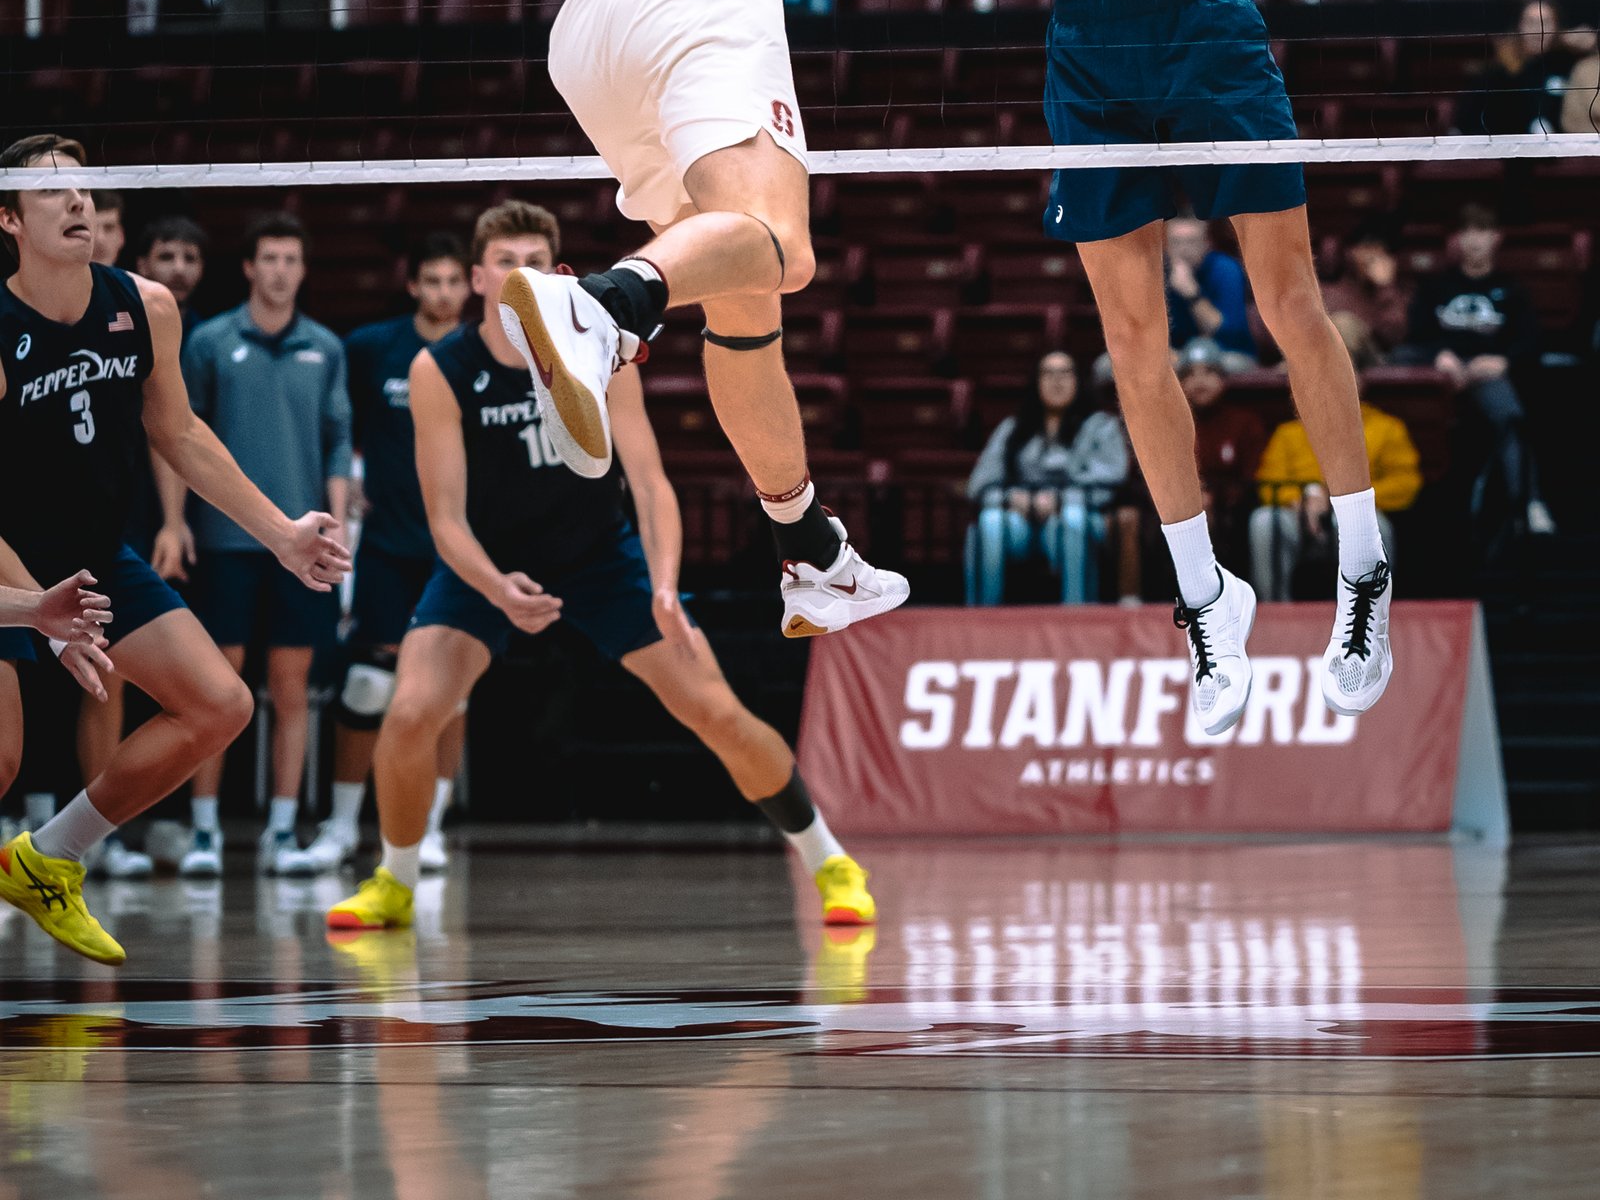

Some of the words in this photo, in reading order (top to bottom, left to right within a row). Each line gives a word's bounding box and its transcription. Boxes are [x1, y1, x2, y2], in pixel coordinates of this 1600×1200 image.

[21, 349, 138, 407] PEPPERDINE
[70, 389, 95, 445] 3
[900, 657, 1359, 749] STANFRD
[1018, 757, 1216, 785] ATHLETICS
